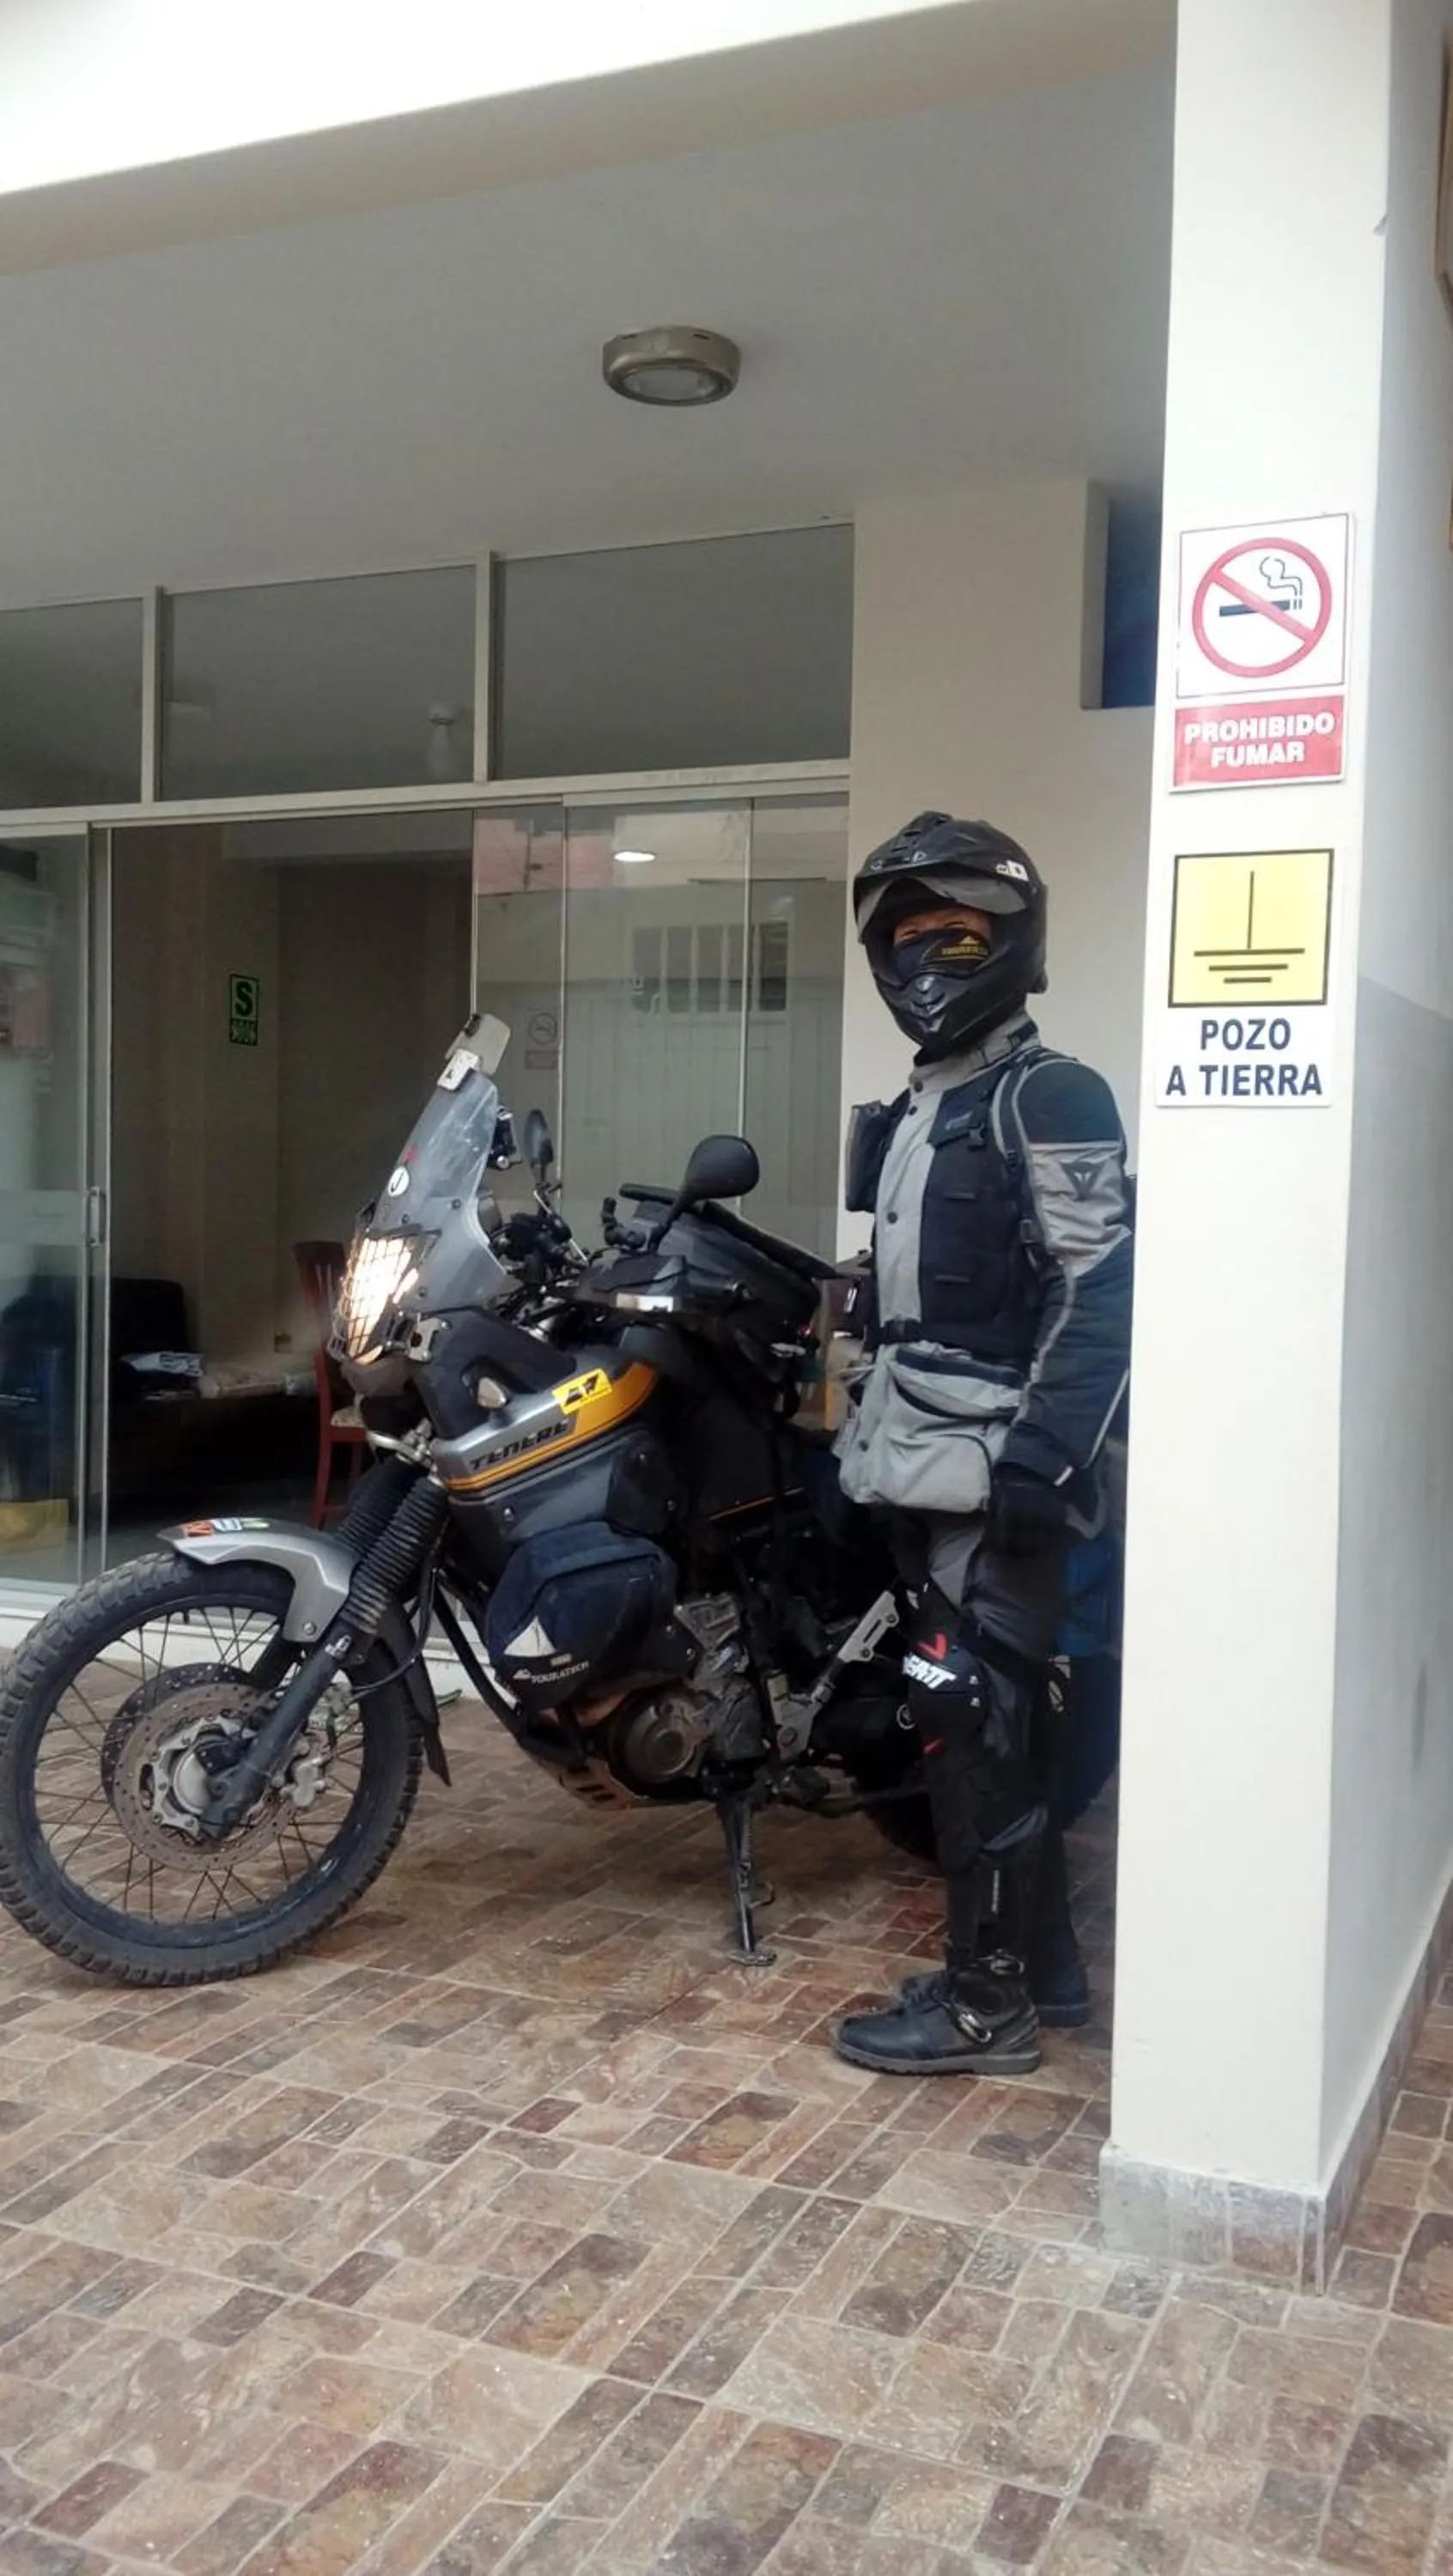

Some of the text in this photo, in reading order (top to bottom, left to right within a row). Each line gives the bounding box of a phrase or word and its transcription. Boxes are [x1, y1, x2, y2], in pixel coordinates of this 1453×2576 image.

[1184, 712, 1335, 744] PROHIBIDO
[1210, 741, 1305, 768] FUMAR
[235, 981, 253, 1018] S
[1200, 1018, 1292, 1051] POZO
[1165, 1063, 1322, 1096] A TIERRA
